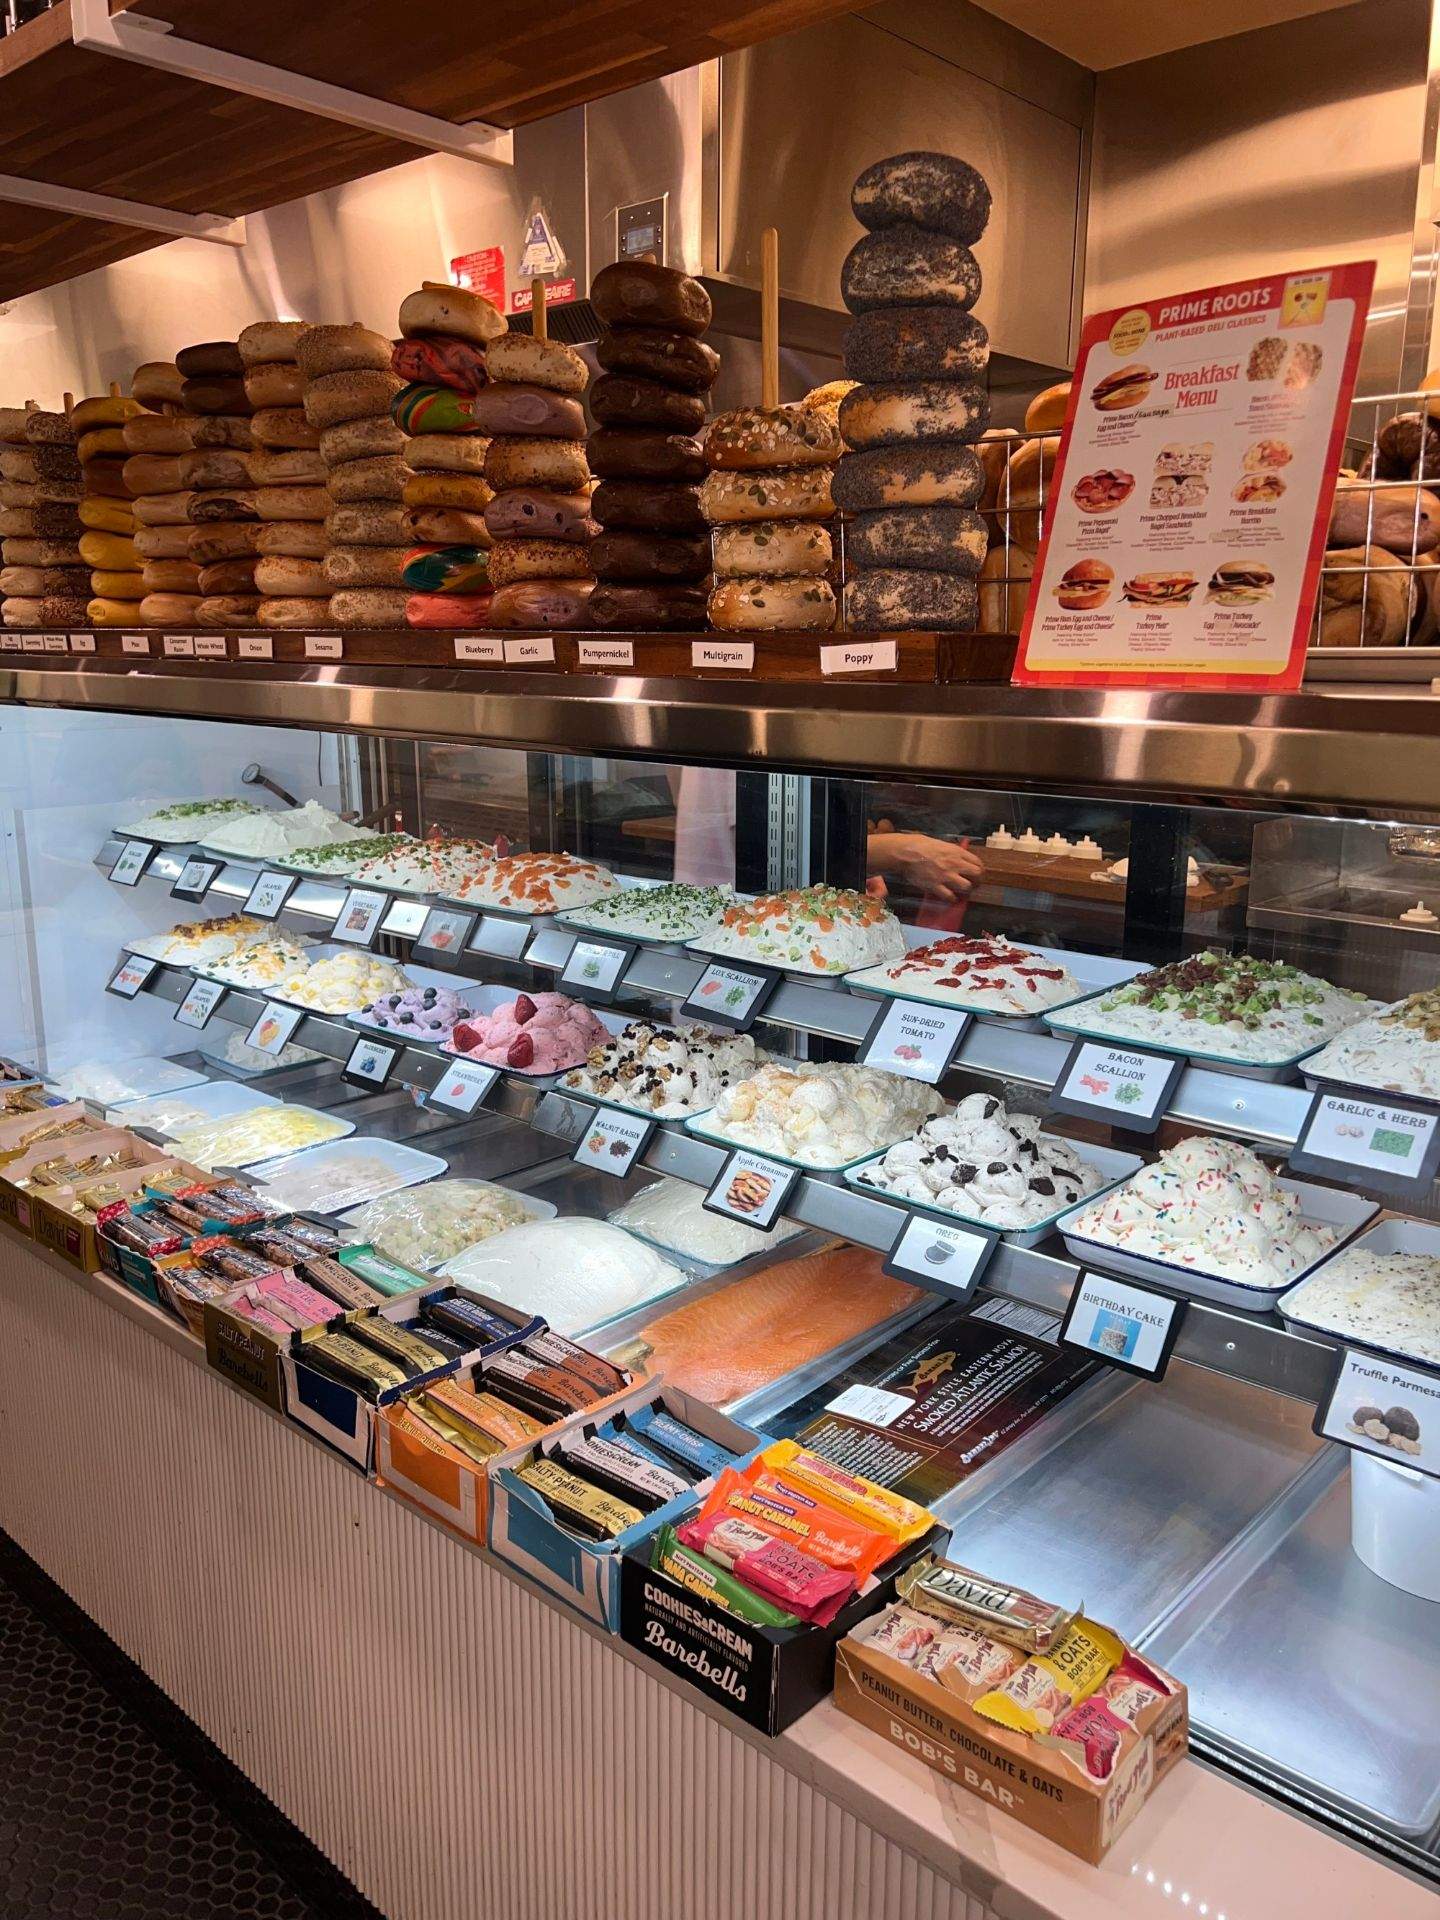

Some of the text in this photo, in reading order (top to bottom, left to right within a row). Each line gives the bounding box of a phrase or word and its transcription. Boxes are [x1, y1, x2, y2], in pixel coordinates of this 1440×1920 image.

[514, 284, 572, 306] CAPEAIRE
[1159, 287, 1273, 325] PRIME ROOTS
[1154, 314, 1267, 343] PLANT-BASED DELI CLASSICS
[1164, 363, 1240, 391] Breakfast
[1175, 389, 1218, 410] Menu
[314, 643, 333, 651] Sesame
[465, 645, 494, 656] Blueberry
[519, 646, 539, 656] Garlic
[583, 647, 630, 659] Pumpernickel
[703, 650, 743, 662] Multigrain
[844, 651, 874, 666] Poppy
[711, 967, 760, 987] LOX SCALLION
[899, 1026, 936, 1041] TOMATO
[901, 1013, 946, 1031] SUN-DRIED
[1107, 1051, 1145, 1067] BACON
[450, 1069, 486, 1085] STRAWBERRY
[1094, 1063, 1147, 1082] SCALLION
[1327, 1100, 1429, 1129] GARLIC & HERB
[594, 1120, 640, 1140] WALNUT RAISIN
[736, 1154, 790, 1180] Apple Cinnamon
[1082, 1291, 1136, 1323] BIRTHDAY
[1135, 1309, 1167, 1328] CAKE
[218, 1351, 269, 1393] Barebells
[896, 1413, 916, 1430] NEW
[914, 1396, 940, 1414] YORK
[937, 1377, 963, 1397] STYLE
[960, 1352, 994, 1378] EASTERN
[991, 1337, 1015, 1354] NOVA
[1350, 1362, 1388, 1382] Truffle
[913, 1399, 957, 1432] SMOKED
[951, 1368, 995, 1402] ATLANTIC
[989, 1344, 1029, 1372] SALMON
[763, 1497, 784, 1511] PROTEIN
[782, 1505, 795, 1515] BAR
[787, 1489, 806, 1504] PROTEIN
[804, 1498, 815, 1508] BAR
[761, 1506, 811, 1537] CARAMEL
[814, 1530, 862, 1558] Barebells
[675, 1552, 714, 1585] SOFT PROTEIN BAR
[926, 1566, 1012, 1611] David
[644, 1603, 749, 1673] NATURALLY AND ARTIFICIALLY FLAVORED
[644, 1620, 747, 1702] Barebells
[1053, 1634, 1091, 1670] & OATS
[1067, 1647, 1100, 1681] BOB'S BAR
[862, 1671, 1064, 1803] PEANUT BUTTER, CHOCOLATE & OATS
[890, 1719, 957, 1775] BOB'S
